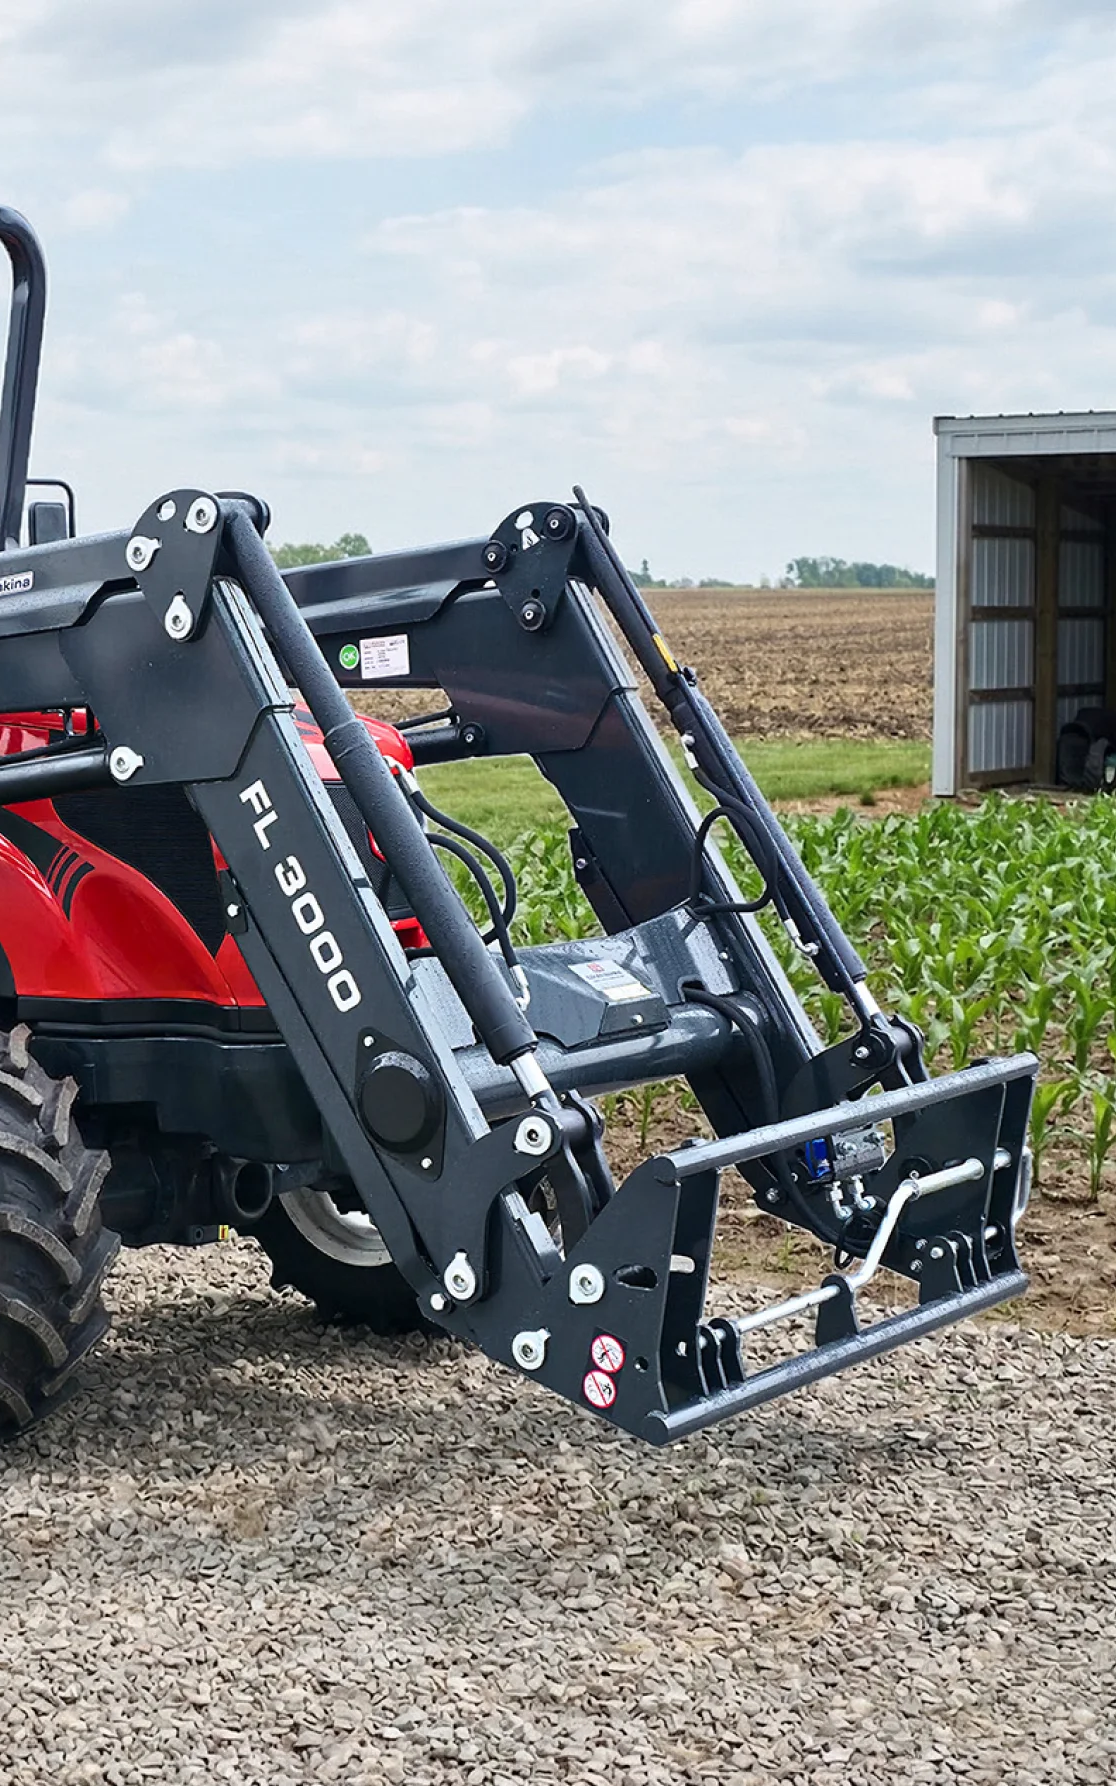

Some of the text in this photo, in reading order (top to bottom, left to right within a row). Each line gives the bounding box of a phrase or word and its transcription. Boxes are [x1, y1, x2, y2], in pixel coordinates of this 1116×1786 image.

[342, 650, 356, 662] OK
[238, 778, 362, 1013] FL 3000
